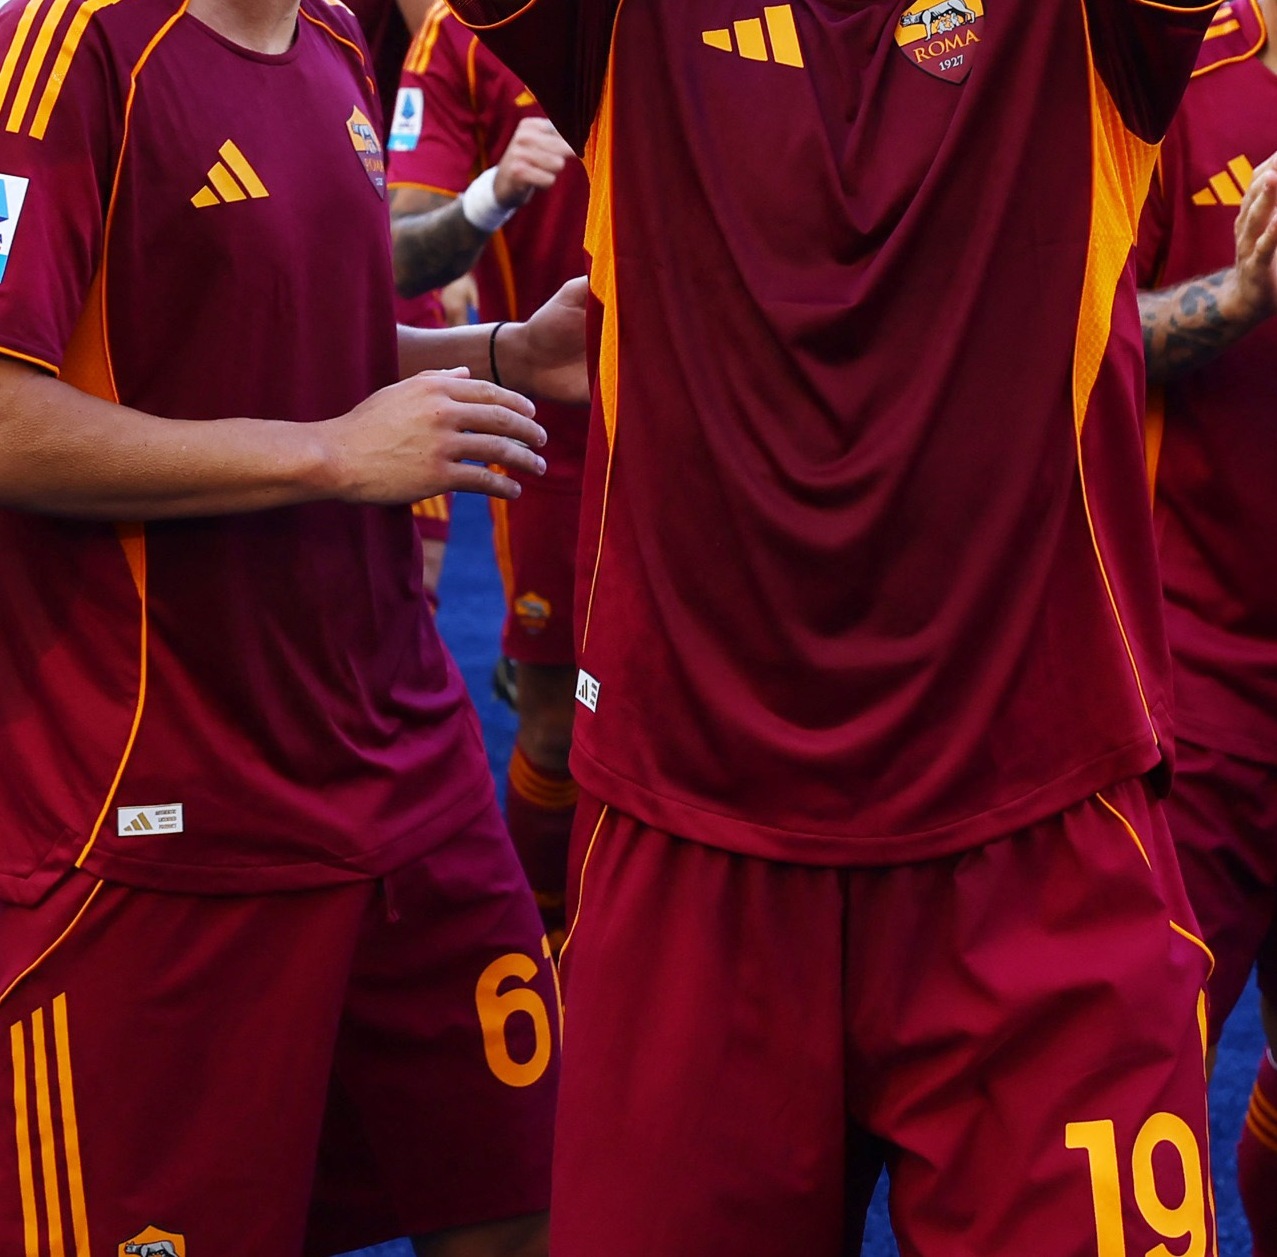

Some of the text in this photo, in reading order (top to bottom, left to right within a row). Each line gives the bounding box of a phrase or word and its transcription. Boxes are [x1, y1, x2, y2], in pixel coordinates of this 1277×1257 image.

[912, 29, 981, 63] ROMA
[938, 54, 964, 72] 1927
[1065, 1112, 1207, 1257] 19
